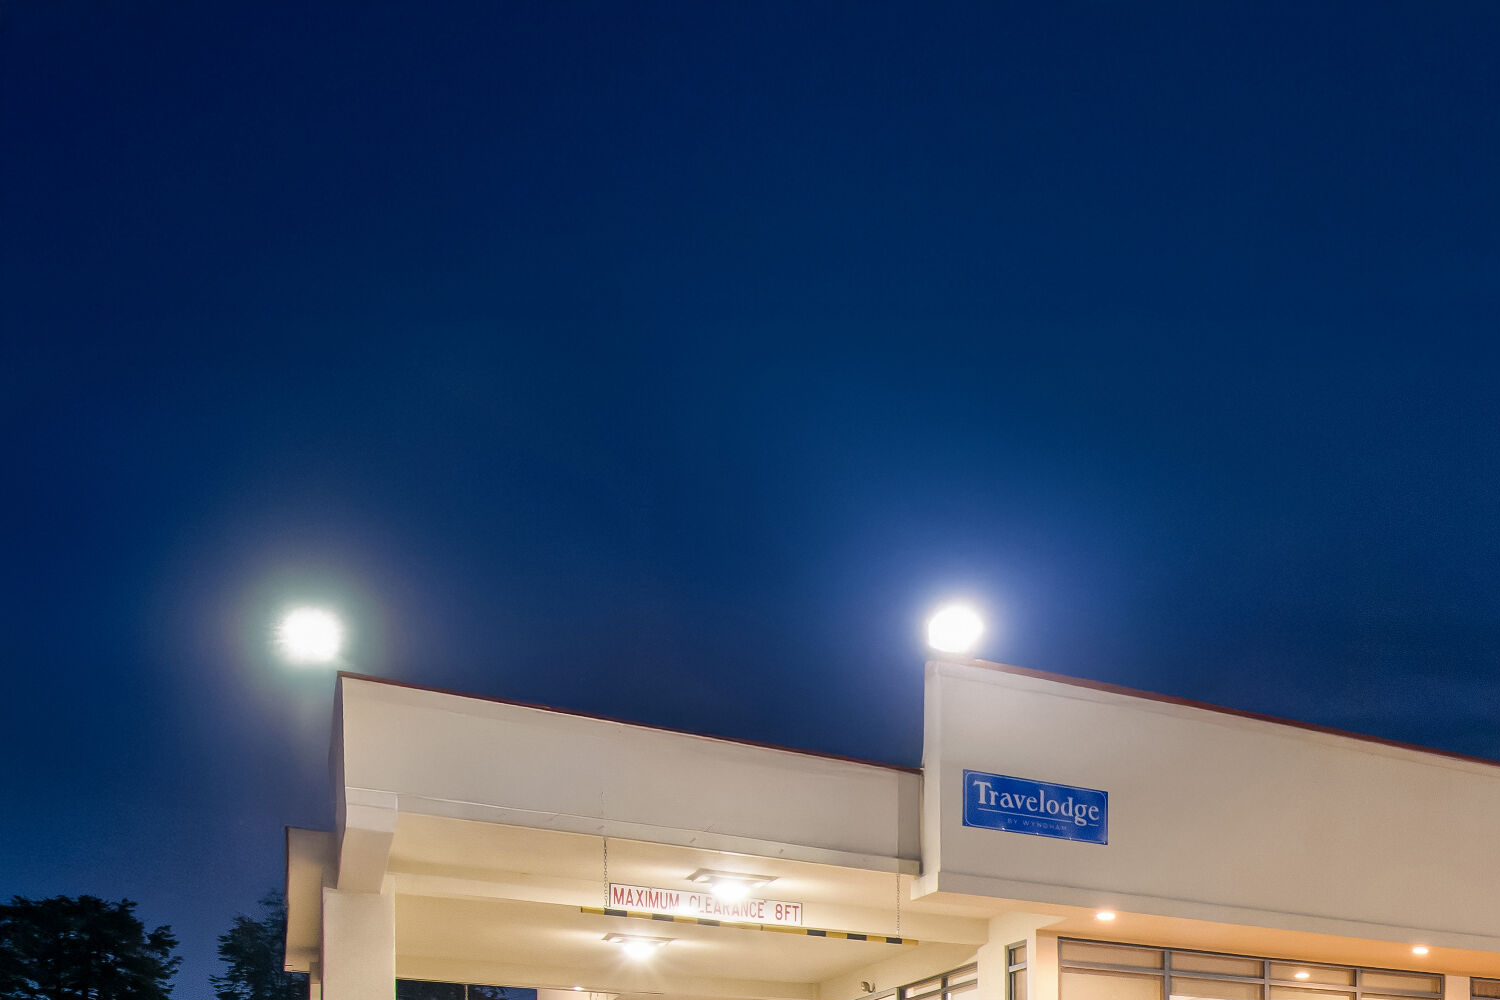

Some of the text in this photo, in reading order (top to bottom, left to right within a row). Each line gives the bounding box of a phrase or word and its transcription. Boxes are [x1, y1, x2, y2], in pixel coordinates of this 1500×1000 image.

[972, 779, 1099, 827] Travelodge
[1023, 820, 1067, 830] WYNDHAM
[613, 886, 800, 922] MAXIMUM CLEARANCE 8FT
